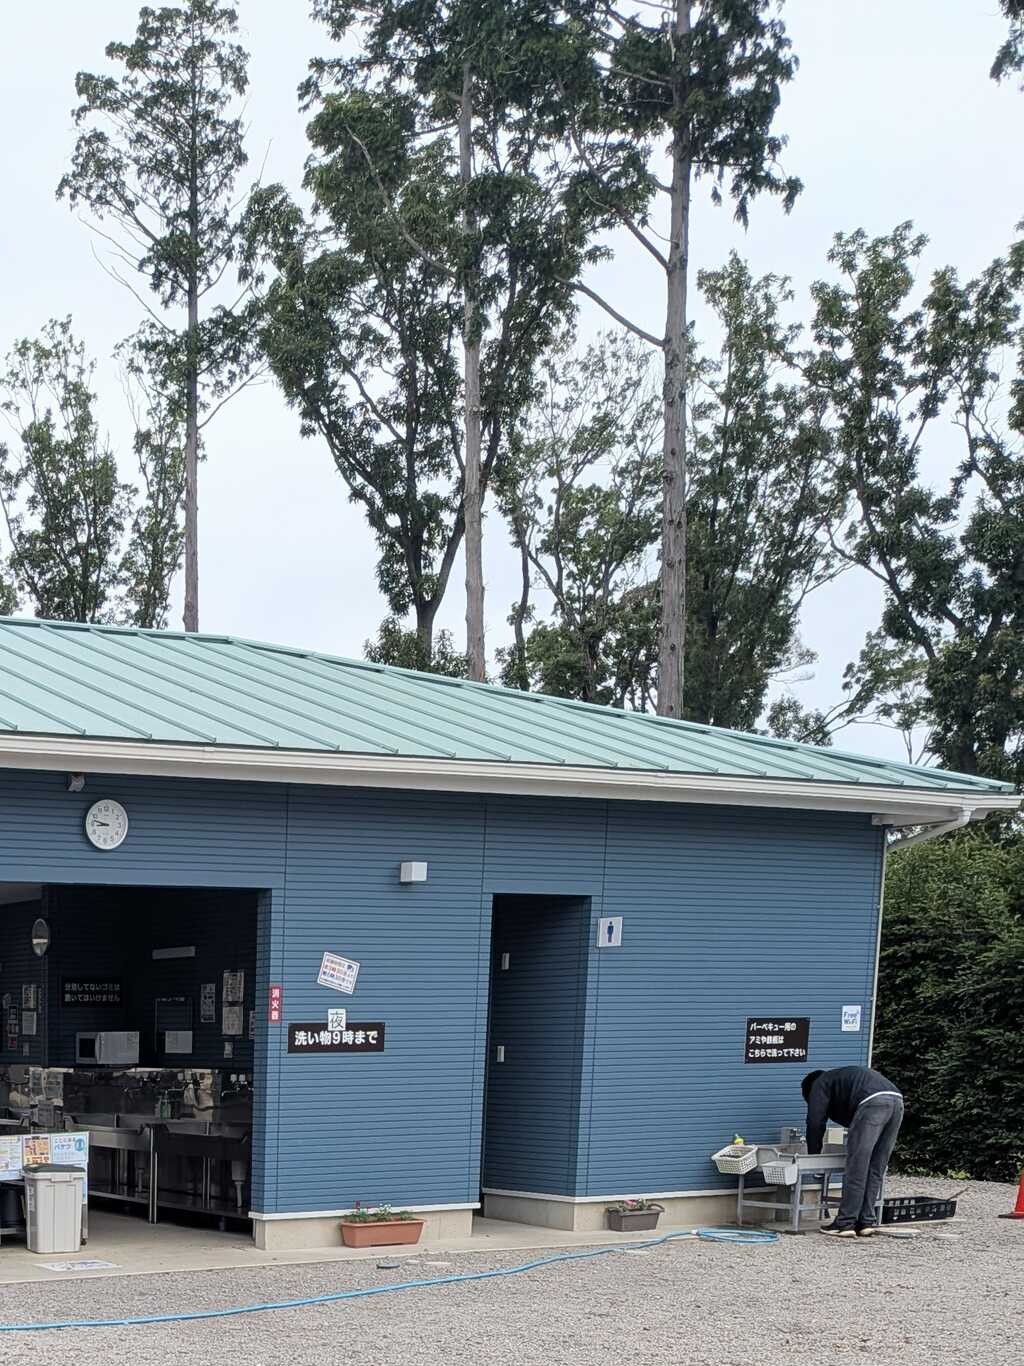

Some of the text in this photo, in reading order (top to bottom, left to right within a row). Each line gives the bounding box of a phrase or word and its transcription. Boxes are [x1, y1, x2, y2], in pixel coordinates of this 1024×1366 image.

[330, 1011, 344, 1029] 夜
[294, 1030, 378, 1046] 洗い物9時まで
